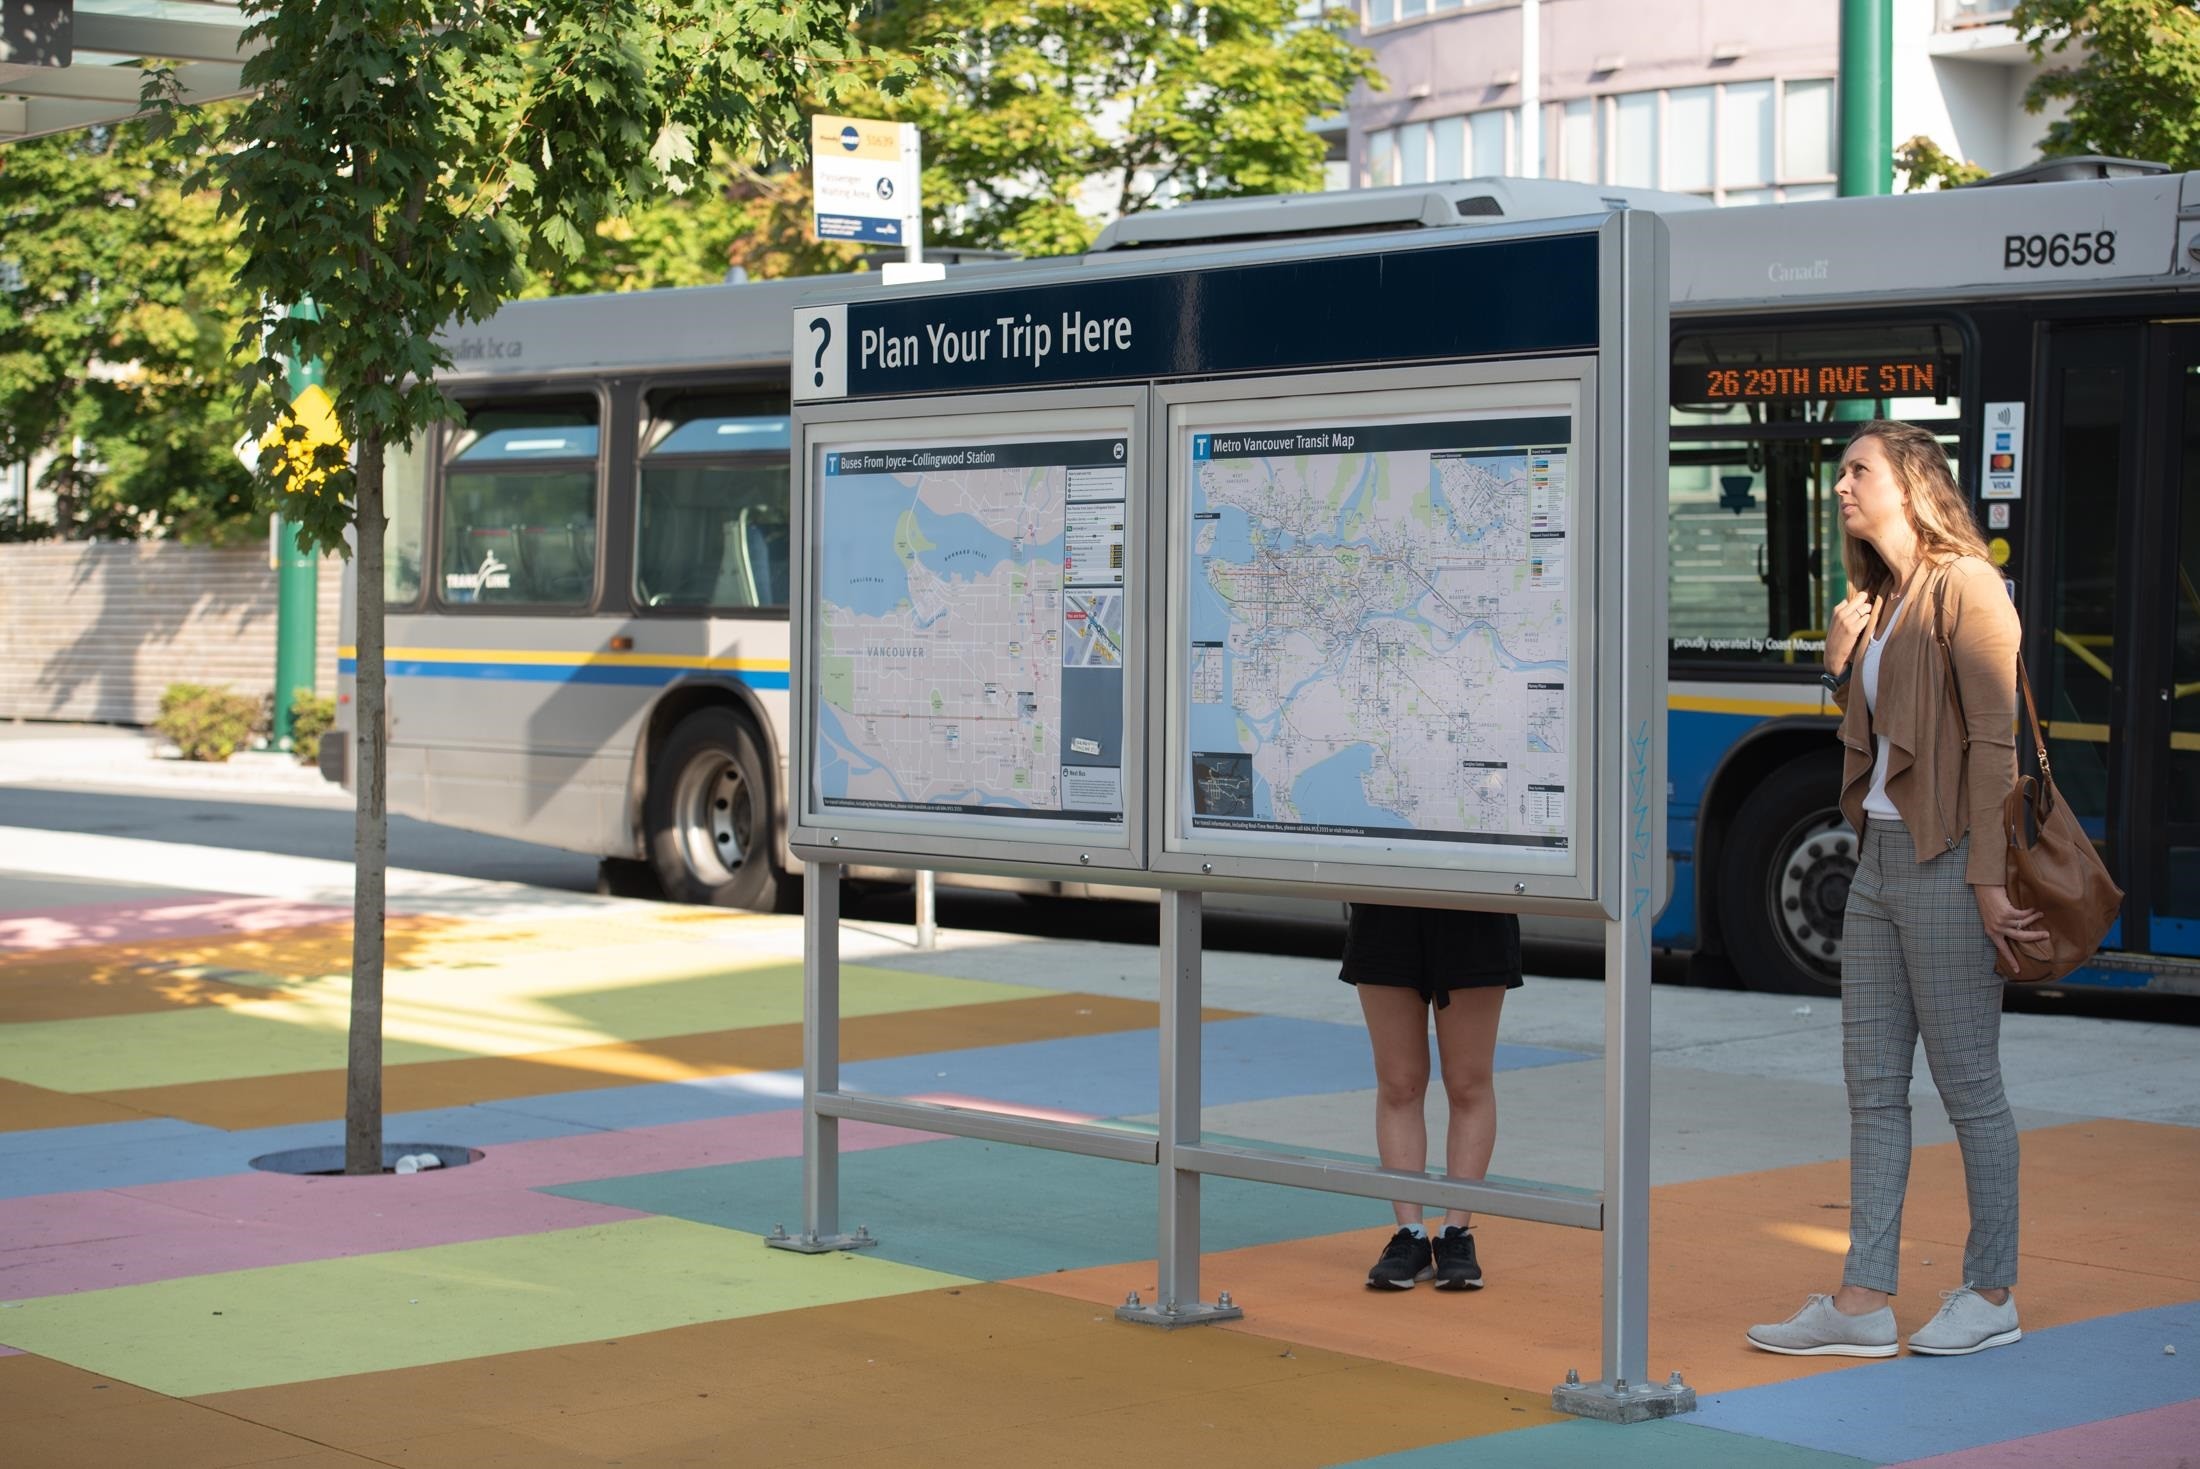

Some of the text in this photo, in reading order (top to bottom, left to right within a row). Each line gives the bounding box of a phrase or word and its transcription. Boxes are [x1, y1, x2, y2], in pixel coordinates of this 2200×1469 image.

[2004, 230, 2116, 270] B9658
[1768, 258, 1828, 282] Canada
[861, 326, 919, 370] Plan
[926, 322, 990, 364] Your
[996, 313, 1052, 368] Trip
[1062, 310, 1132, 354] Here
[1706, 363, 1934, 397] 26 29TH AVE STN
[1213, 439, 1241, 453] Metro
[1243, 437, 1294, 451] Vancouver
[1296, 434, 1329, 448] Transit
[1332, 433, 1355, 449] Map
[841, 456, 862, 470] Buses
[864, 455, 884, 468] From
[966, 450, 996, 464] Station
[1992, 481, 2012, 490] VISA
[867, 646, 925, 657] VANCOUVER
[1674, 637, 1708, 650] proudly
[1710, 638, 1750, 650] operated
[1752, 638, 1764, 652] by
[1765, 638, 1792, 650] Coast
